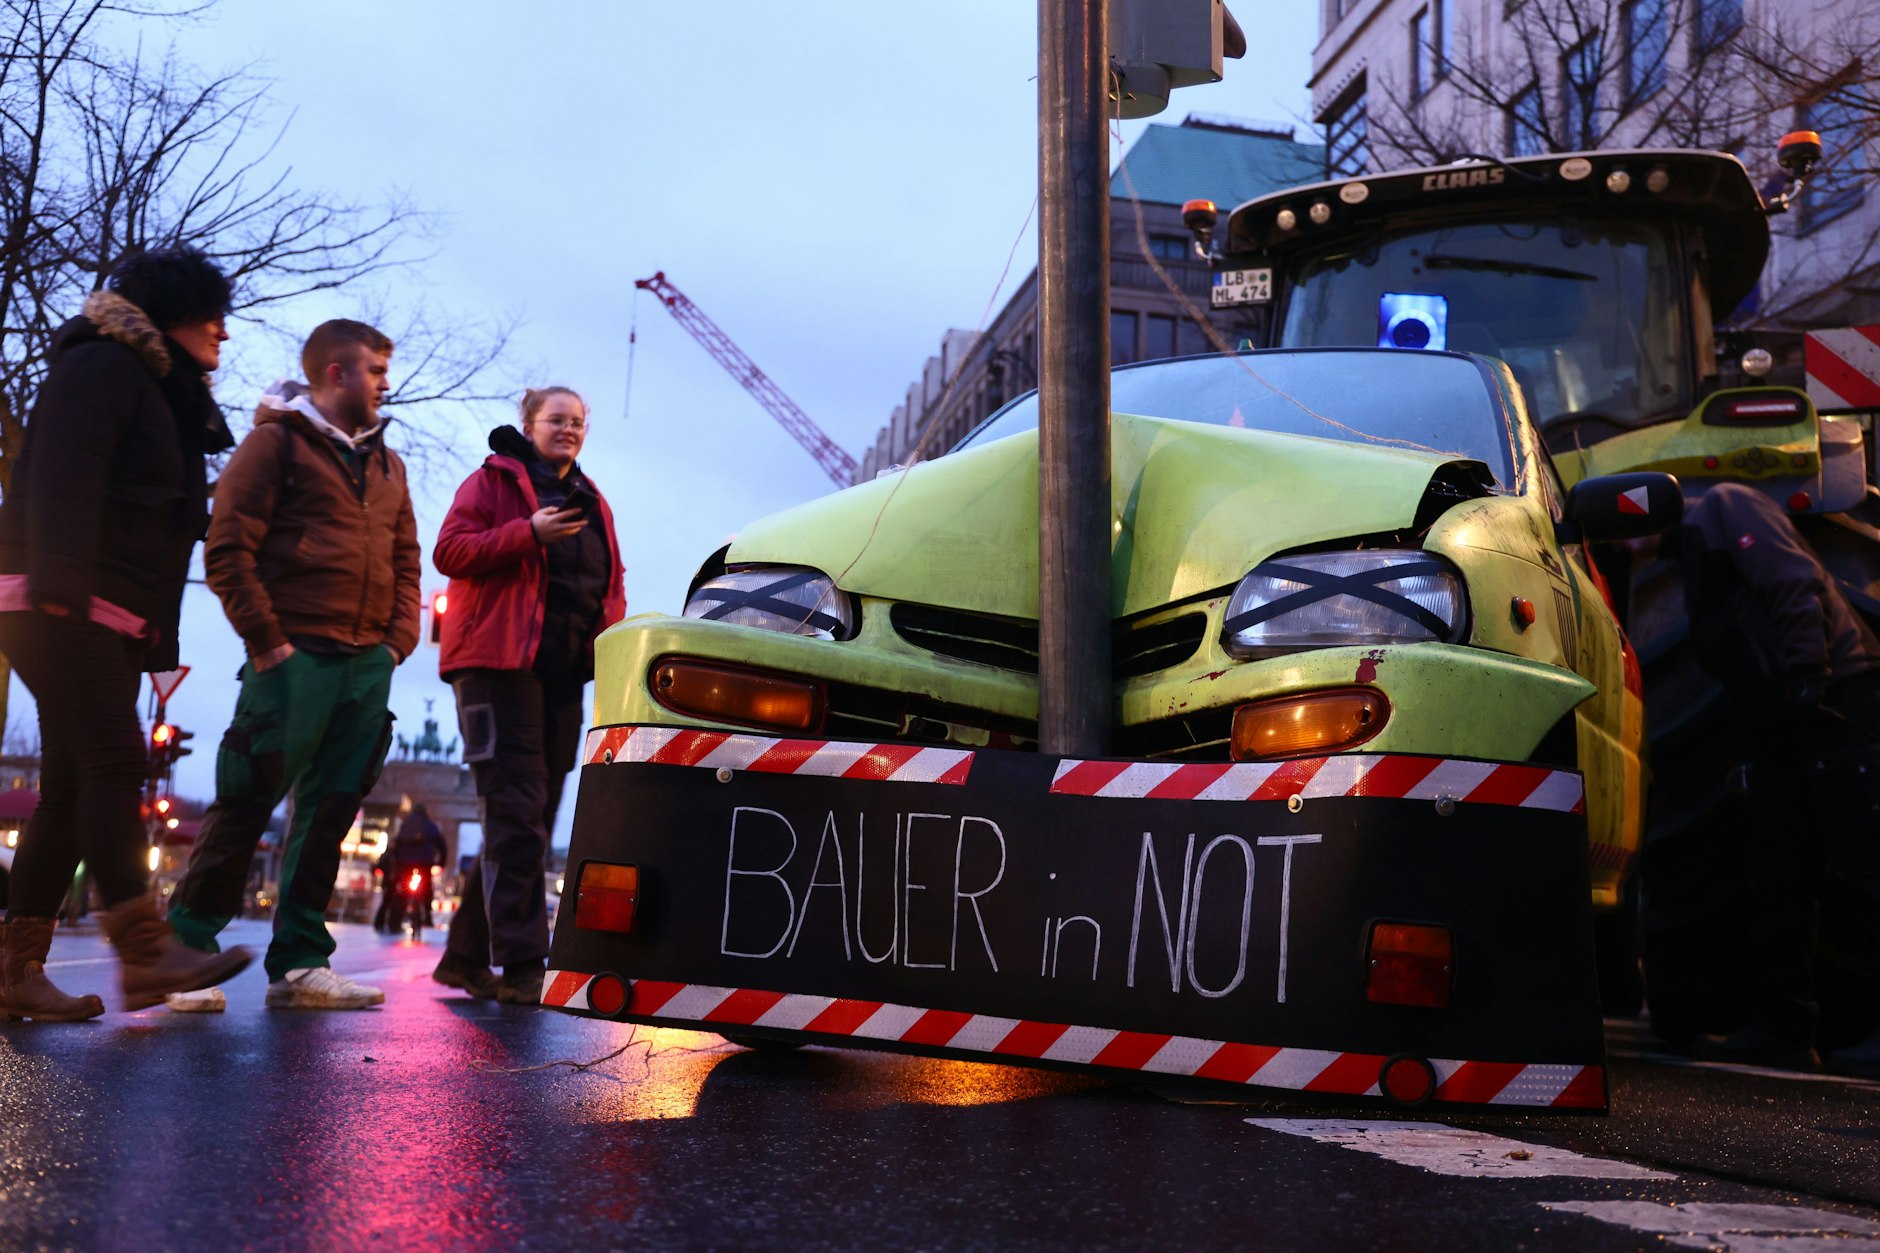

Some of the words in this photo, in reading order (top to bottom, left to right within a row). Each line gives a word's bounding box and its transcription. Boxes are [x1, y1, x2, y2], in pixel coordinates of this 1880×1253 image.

[1422, 168, 1505, 191] CLAAS
[1225, 271, 1245, 286] LB
[1215, 287, 1234, 302] ML
[1240, 284, 1268, 300] 474
[721, 806, 1006, 972] BAUER
[1041, 872, 1101, 981] in
[1127, 831, 1323, 1003] NOT
